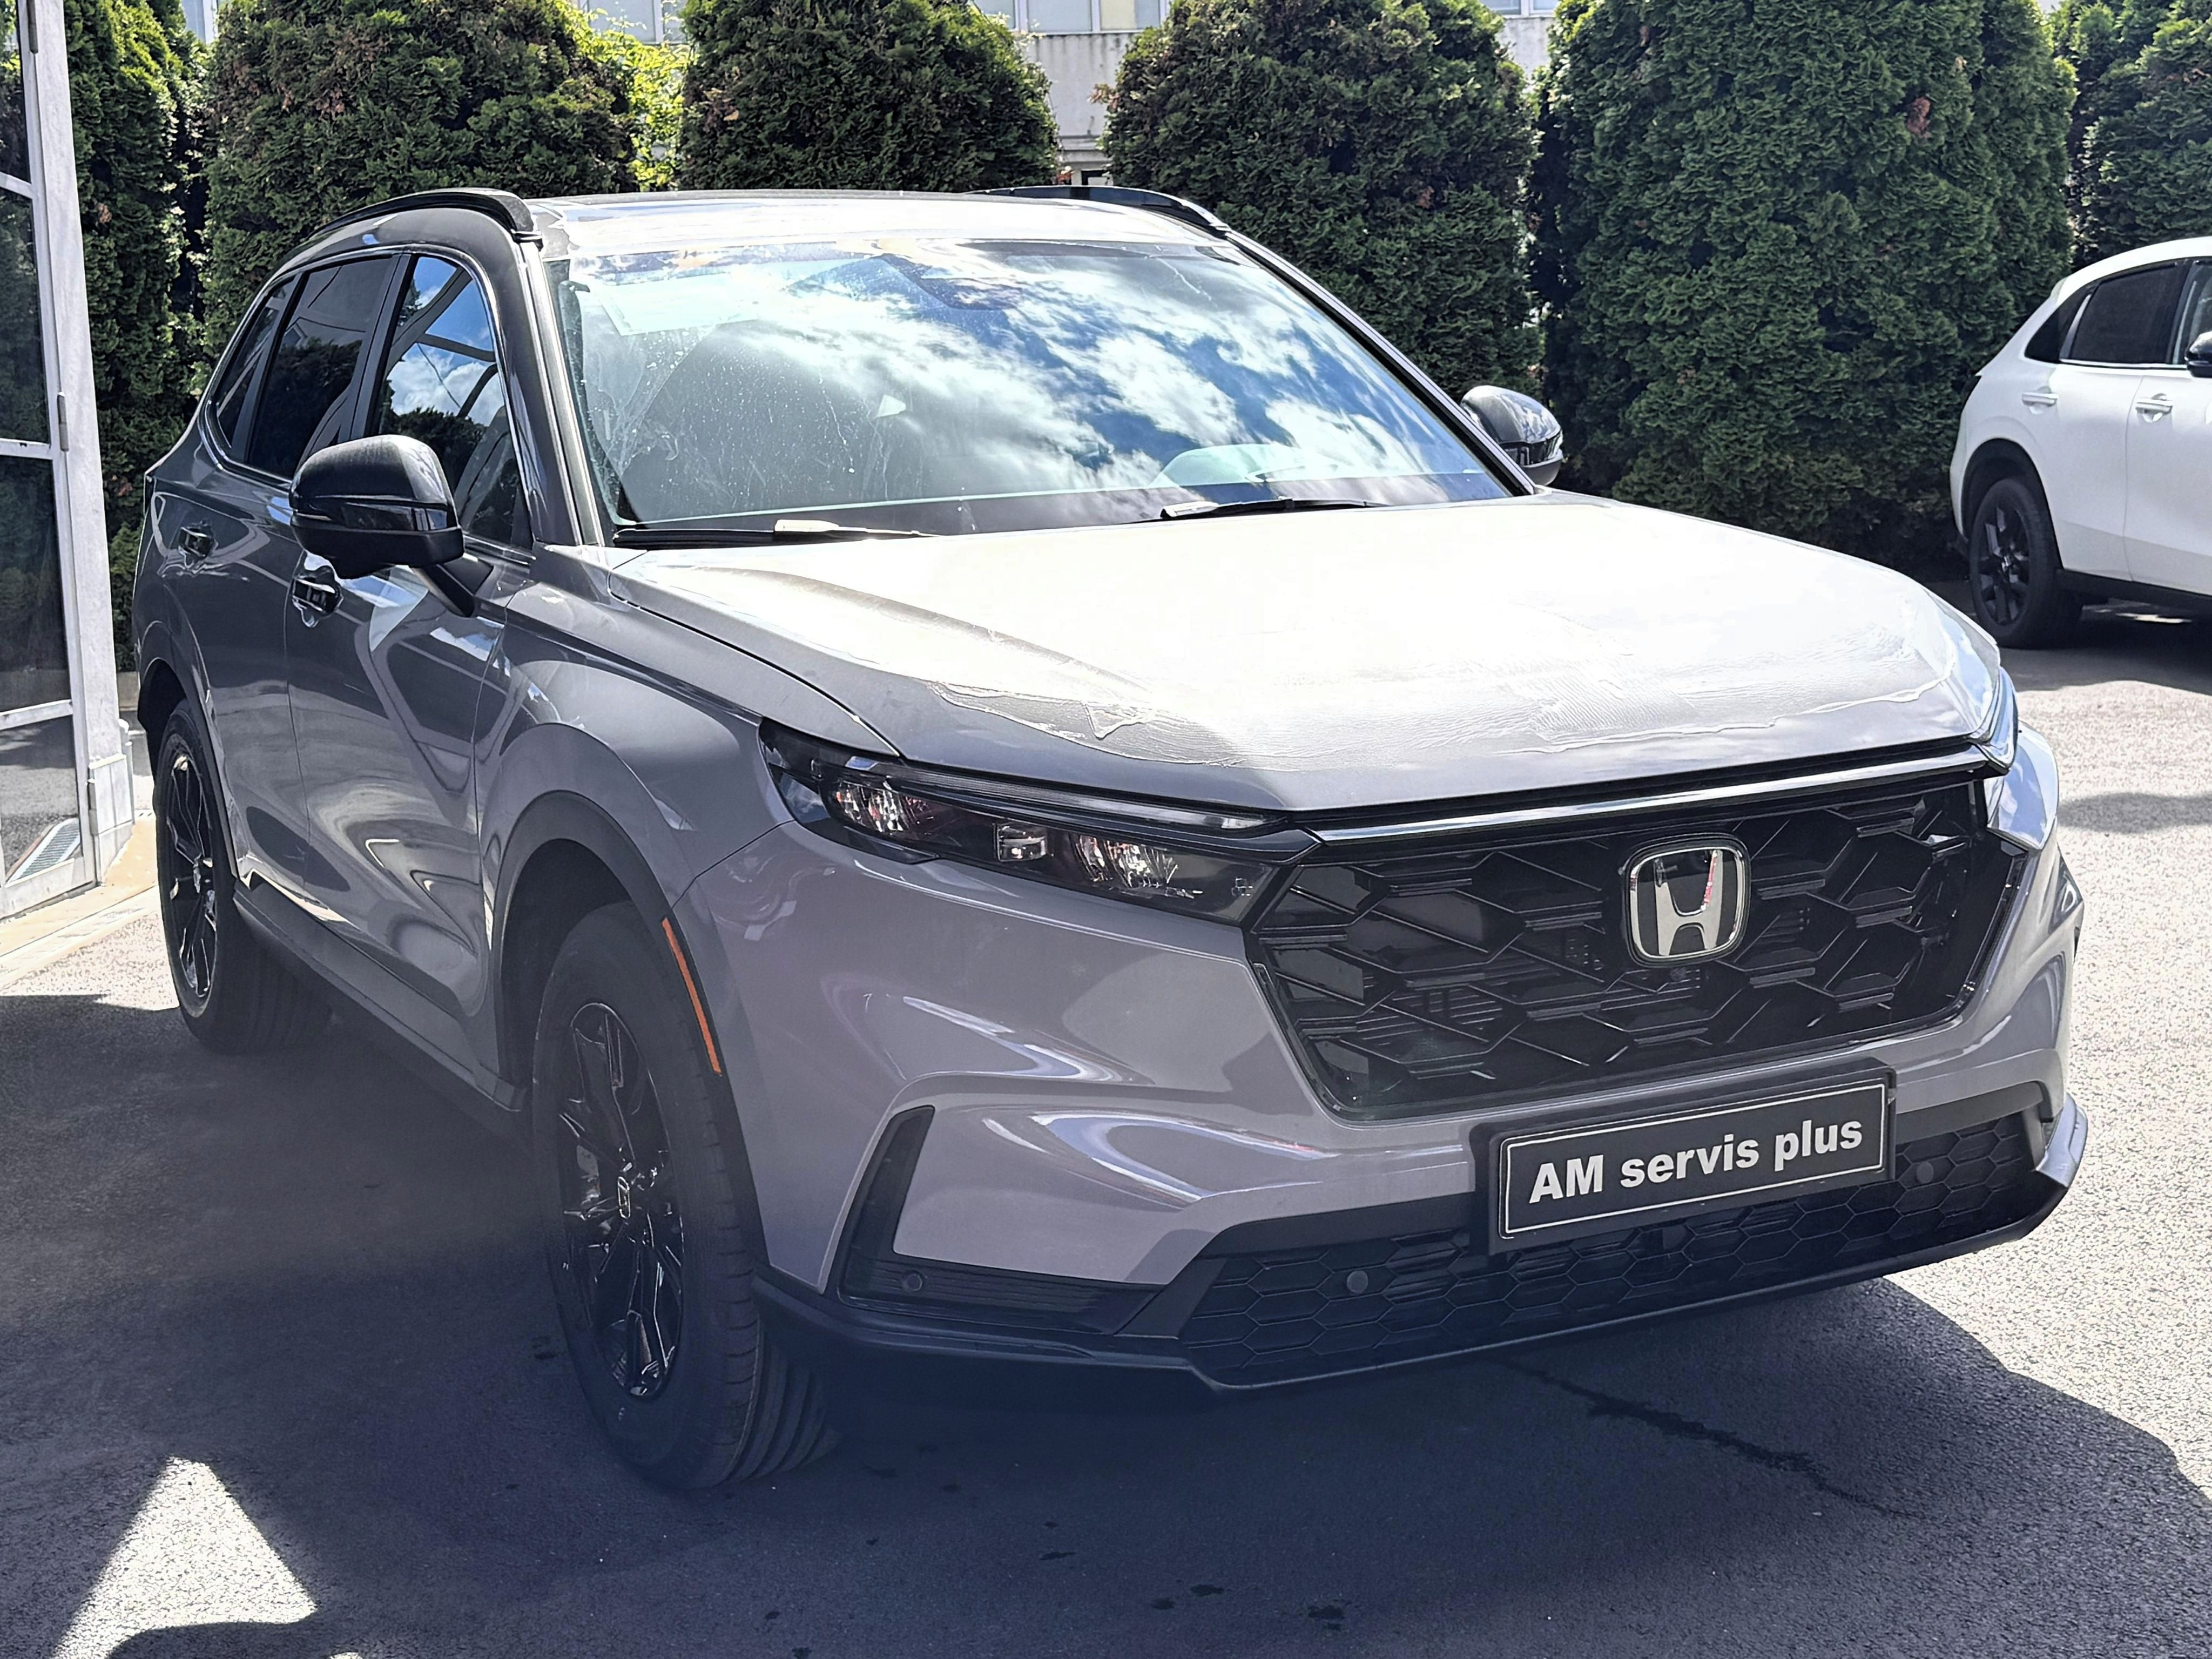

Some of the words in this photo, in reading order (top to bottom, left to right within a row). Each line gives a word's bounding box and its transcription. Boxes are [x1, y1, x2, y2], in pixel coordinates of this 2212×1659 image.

[1529, 1154, 1604, 1204] AM
[1620, 1134, 1759, 1188] servis
[1775, 1120, 1863, 1172] plus
